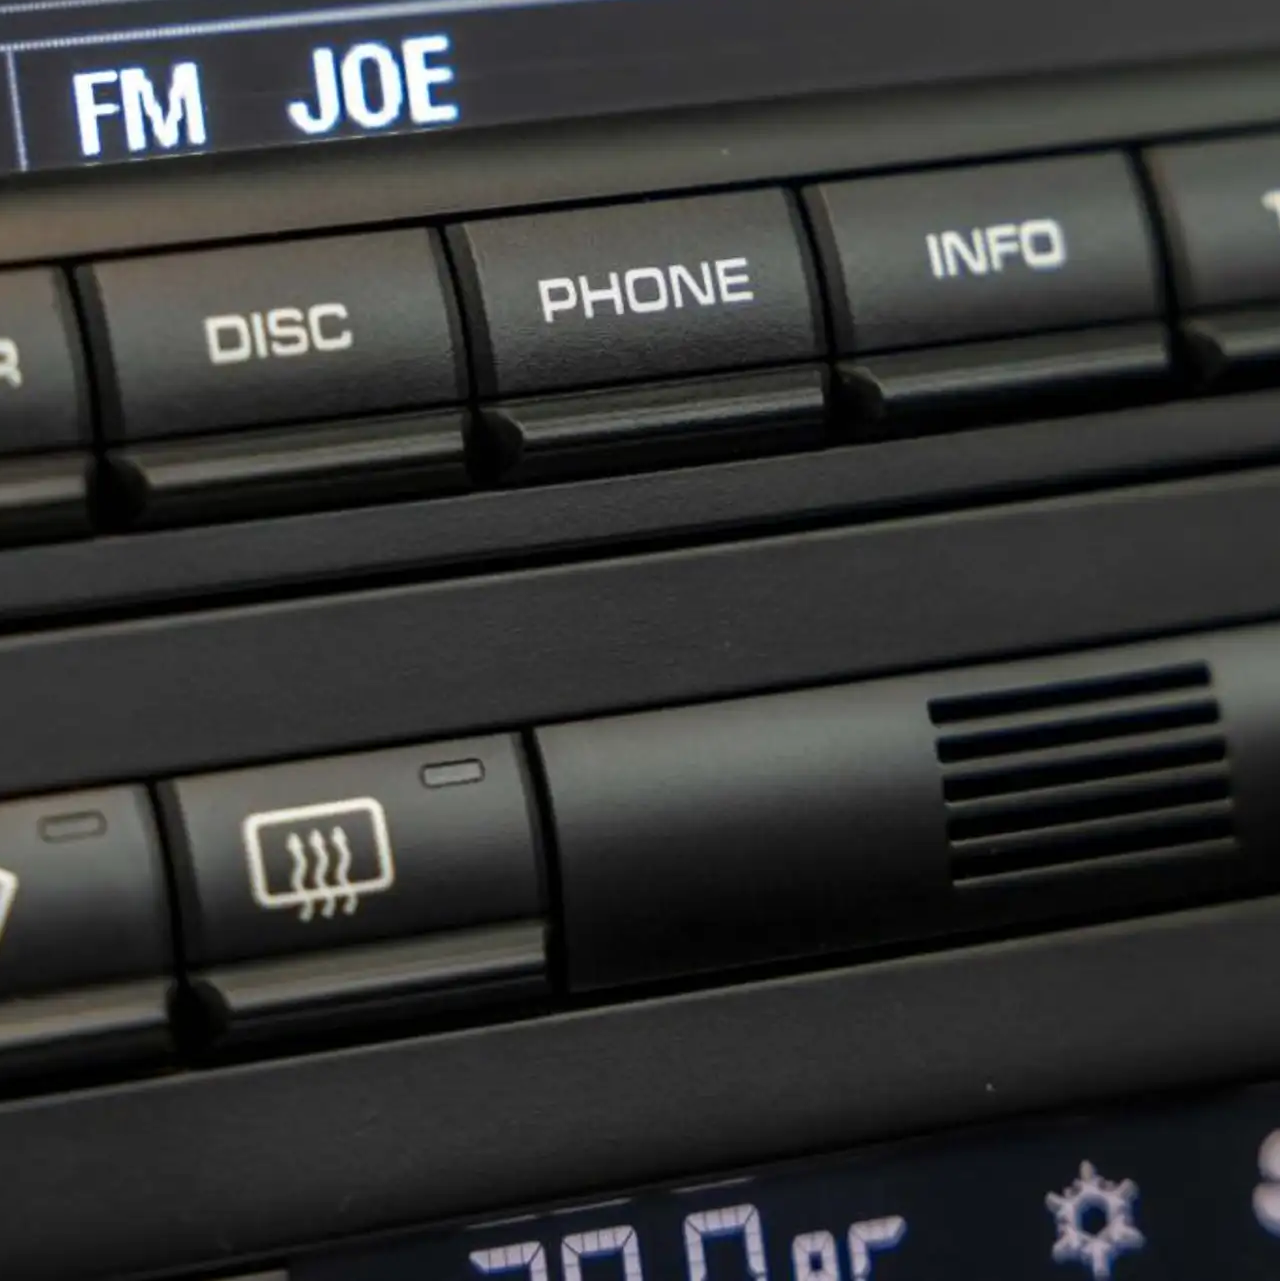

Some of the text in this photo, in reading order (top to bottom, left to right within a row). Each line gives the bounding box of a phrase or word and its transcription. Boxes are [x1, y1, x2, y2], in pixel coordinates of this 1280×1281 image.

[72, 34, 460, 157] FM JOE
[926, 218, 1067, 279] INFO
[537, 257, 755, 323] PHONE
[204, 302, 353, 364] DISC
